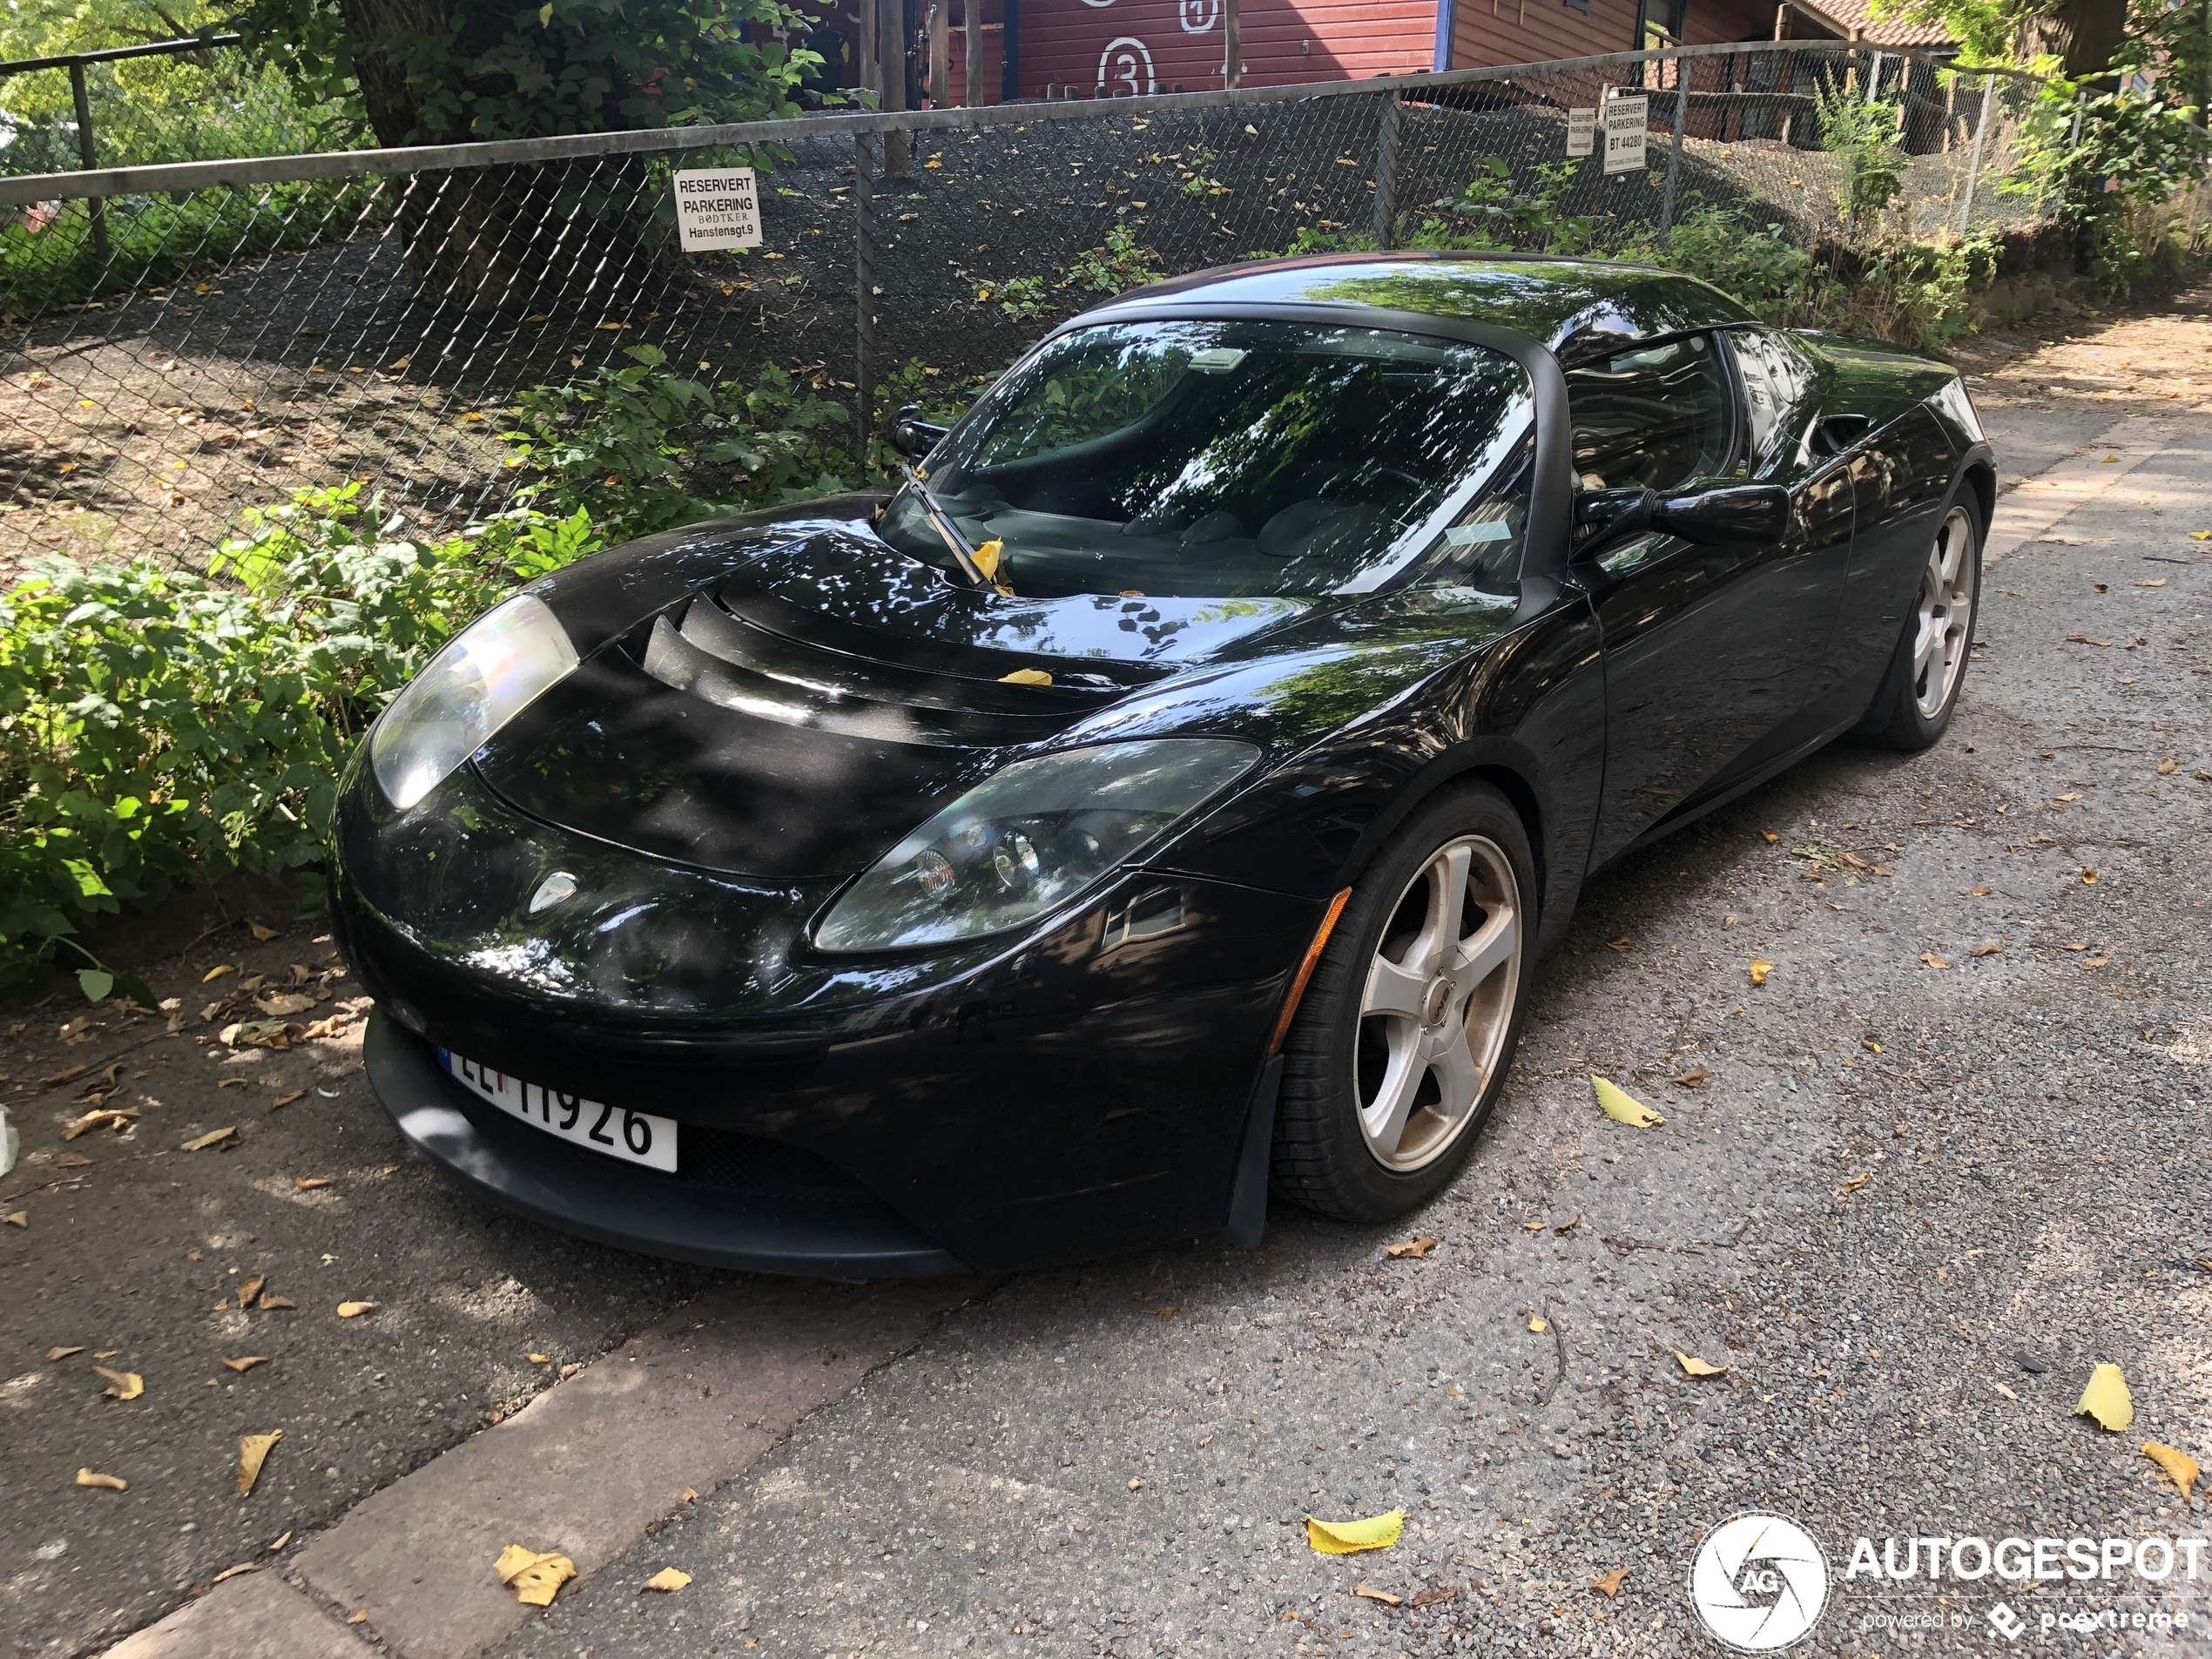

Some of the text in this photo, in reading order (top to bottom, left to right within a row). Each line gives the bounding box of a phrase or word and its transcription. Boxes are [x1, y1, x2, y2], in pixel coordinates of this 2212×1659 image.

[1116, 53, 1139, 96] 3
[1608, 102, 1645, 117] RESERVERT
[1608, 116, 1645, 131] PARKERING
[1609, 134, 1642, 151] BT 44280
[679, 178, 751, 193] RESERVERT
[684, 198, 753, 213] PARKERING
[698, 212, 749, 225] BØDTKER
[689, 225, 753, 239] Hanstensgt.9
[521, 1079, 652, 1155] 11926
